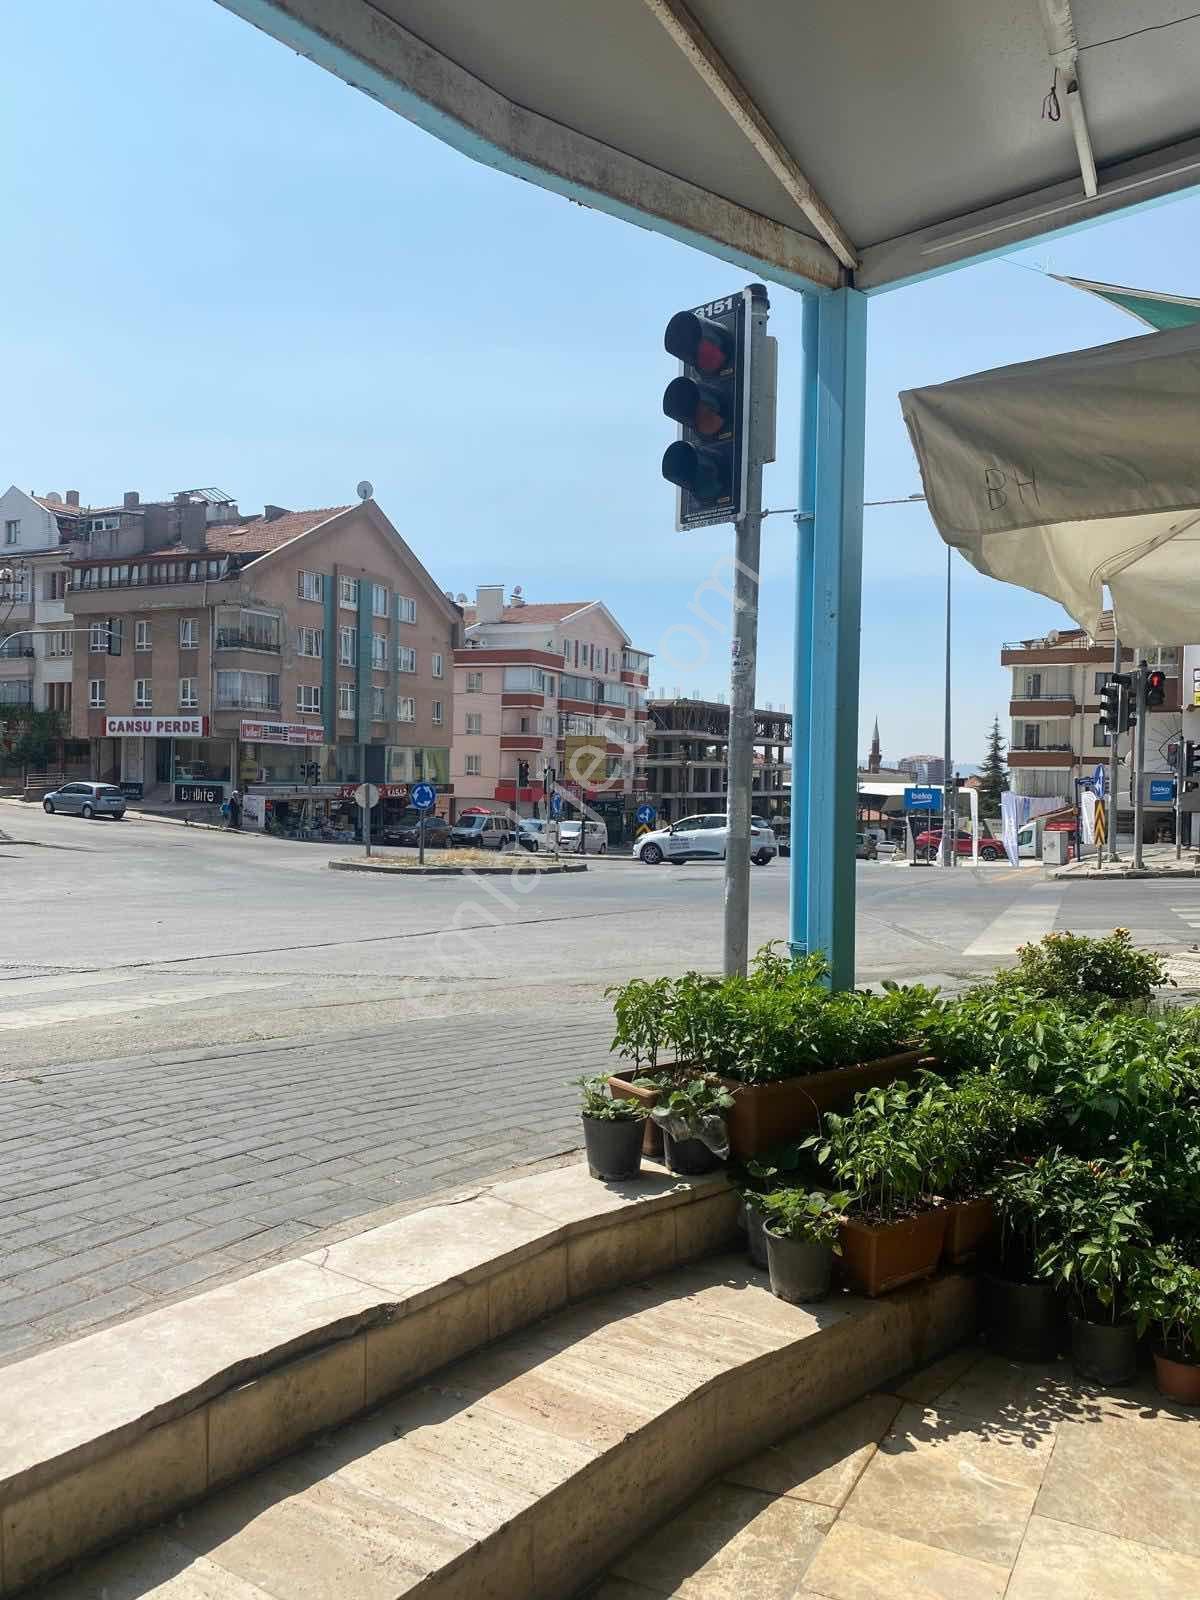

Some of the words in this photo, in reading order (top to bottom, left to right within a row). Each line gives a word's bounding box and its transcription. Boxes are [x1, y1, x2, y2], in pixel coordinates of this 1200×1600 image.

[108, 720, 152, 733] CANSU
[156, 720, 200, 733] PERDE
[911, 791, 932, 800] beko
